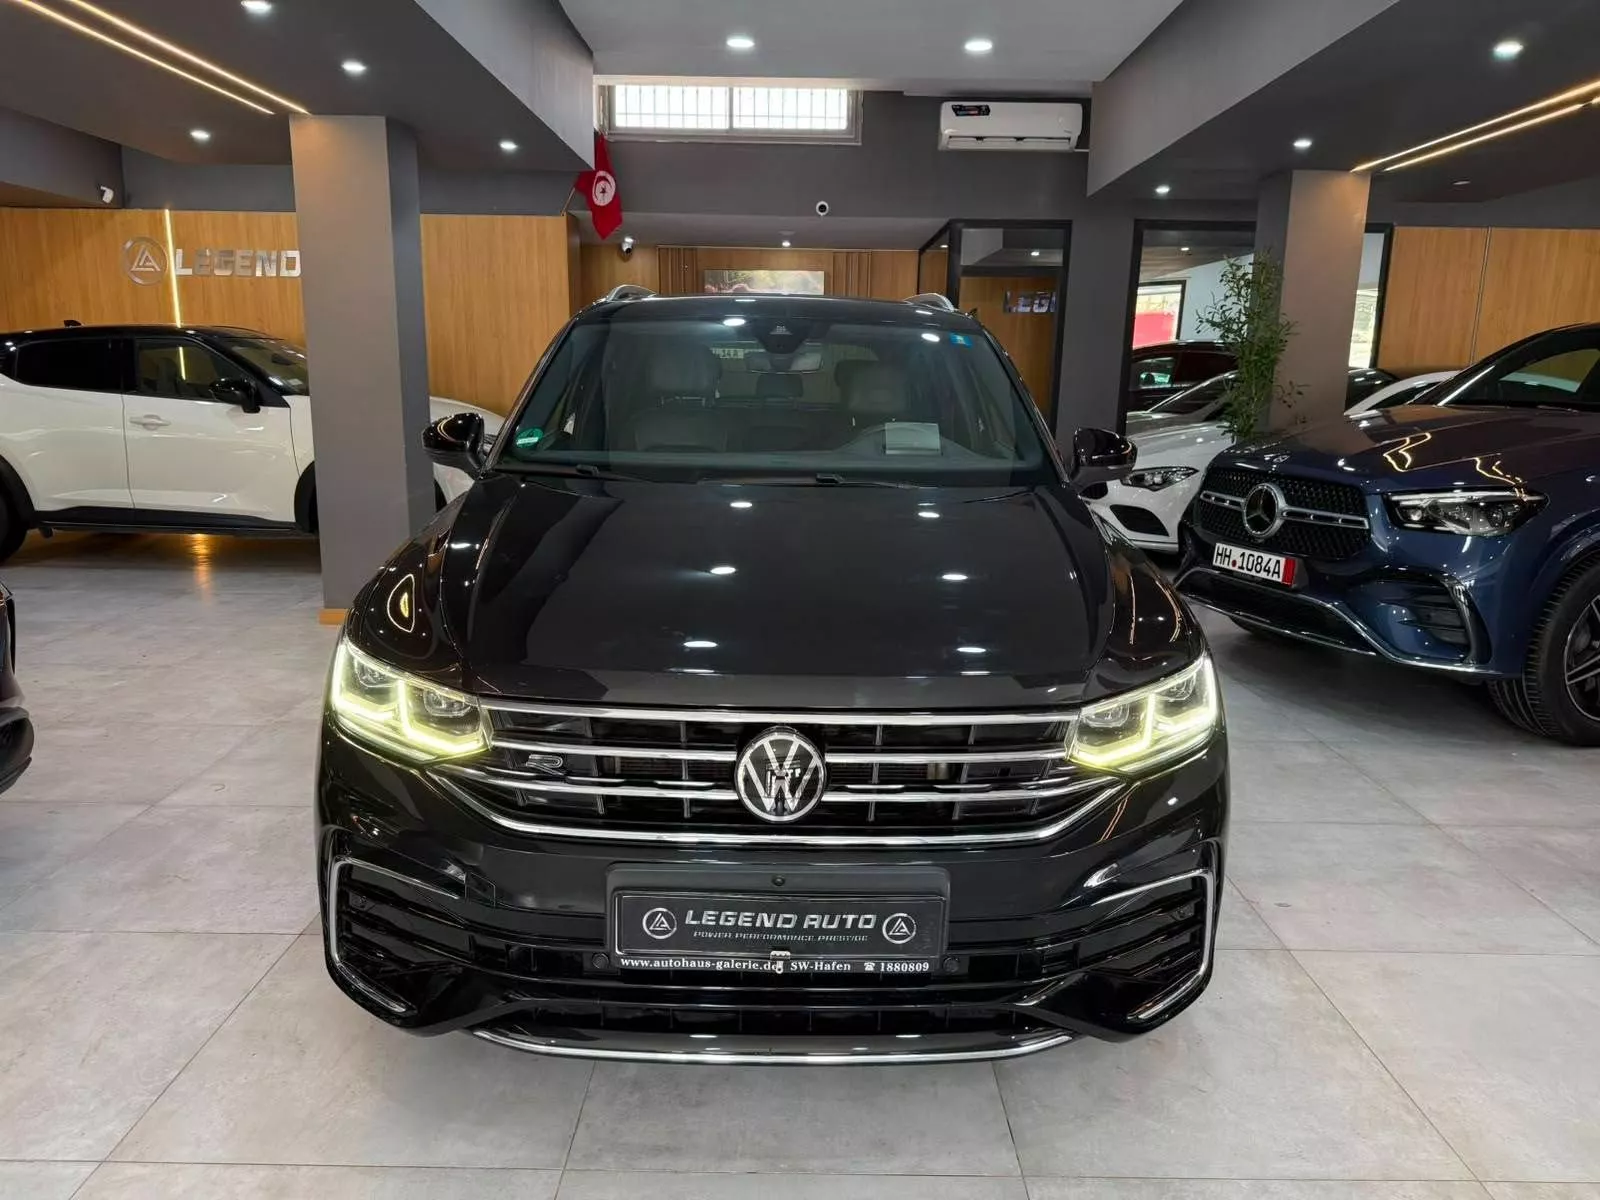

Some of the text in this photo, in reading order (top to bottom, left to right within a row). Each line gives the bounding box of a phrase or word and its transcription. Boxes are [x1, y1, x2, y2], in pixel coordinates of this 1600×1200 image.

[175, 248, 301, 277] LEGEND
[1214, 546, 1281, 579] HH 1084A
[685, 909, 798, 929] LEGEND
[803, 914, 877, 929] AUTO
[790, 961, 851, 971] SW-Hafen
[880, 962, 930, 972] 1880809
